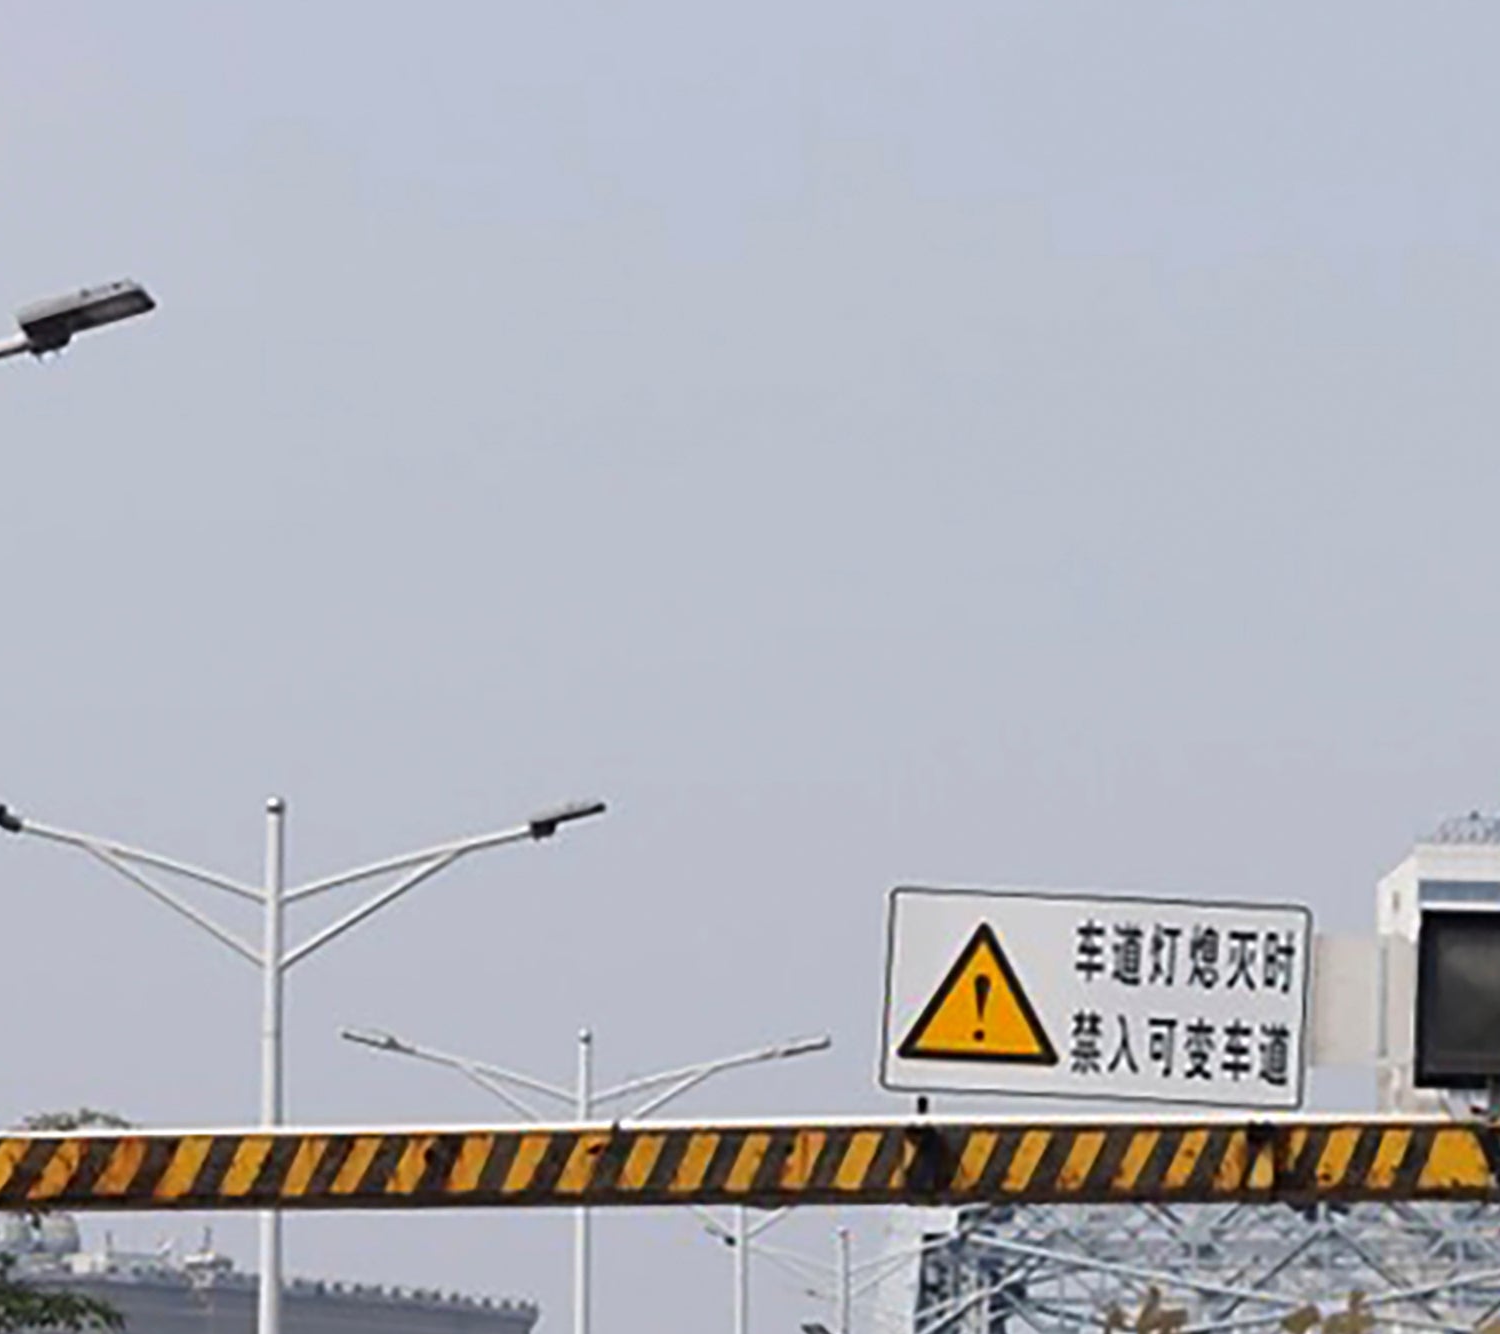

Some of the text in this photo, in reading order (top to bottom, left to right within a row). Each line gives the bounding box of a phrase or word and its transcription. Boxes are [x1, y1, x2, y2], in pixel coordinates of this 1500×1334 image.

[1074, 920, 1296, 992] 车道灯熄灭时
[1070, 1008, 1290, 1086] 禁入可变车道
